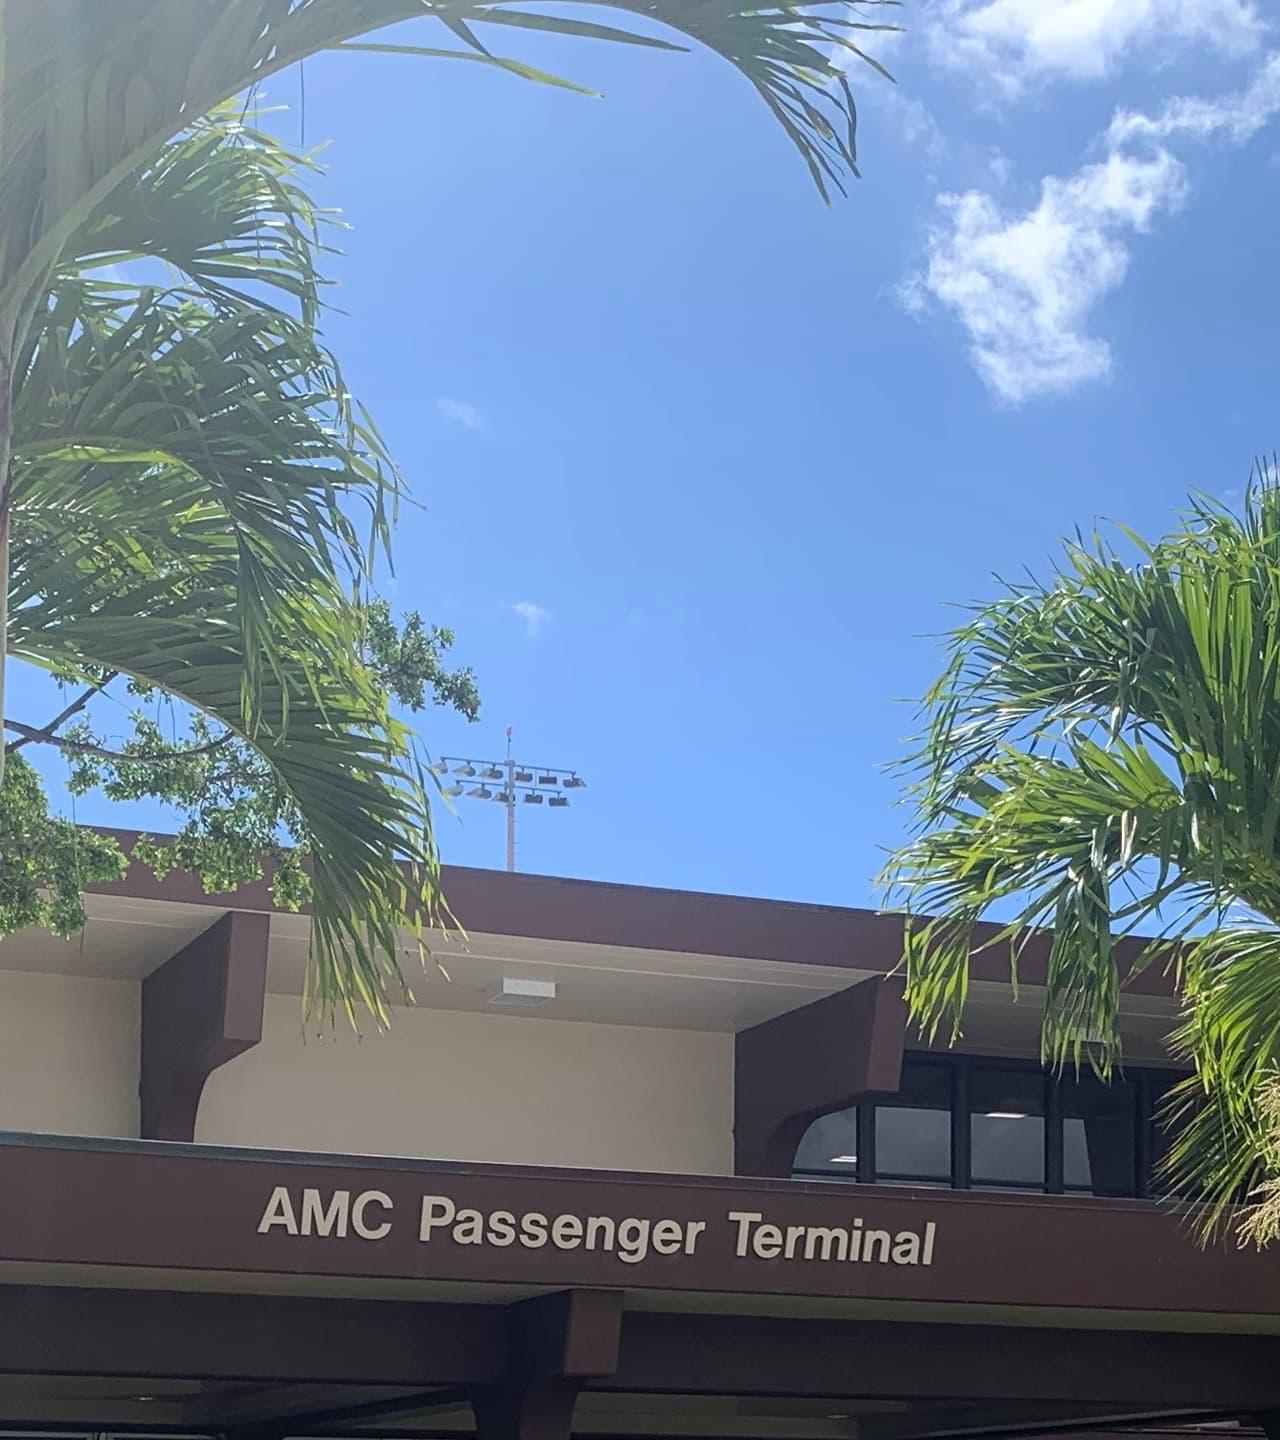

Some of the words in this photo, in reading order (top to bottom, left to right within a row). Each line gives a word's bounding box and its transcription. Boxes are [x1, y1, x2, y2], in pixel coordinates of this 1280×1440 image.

[257, 1186, 394, 1240] AMC
[419, 1195, 706, 1264] Passenger
[728, 1211, 937, 1266] Terminal
